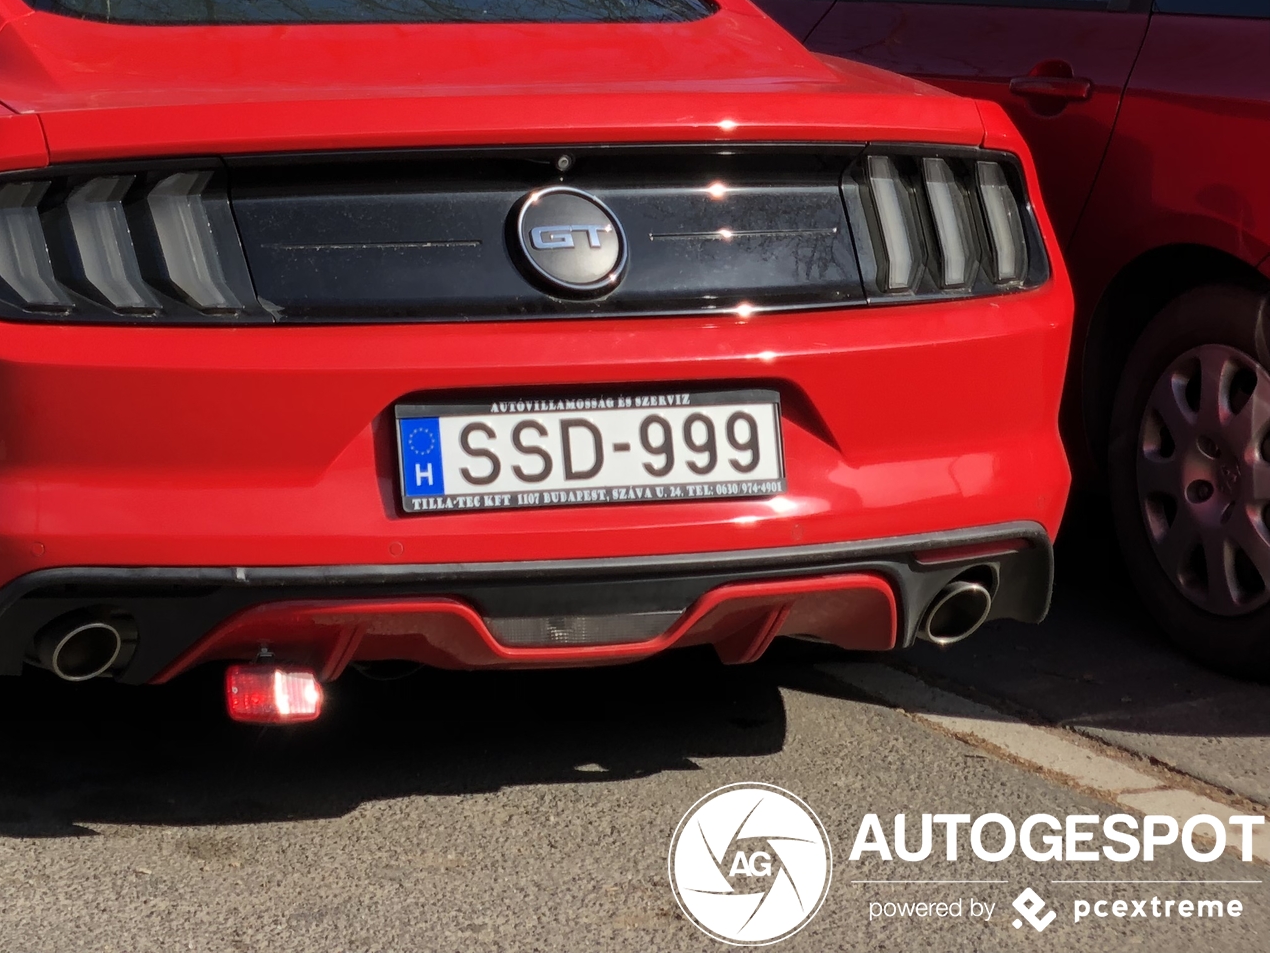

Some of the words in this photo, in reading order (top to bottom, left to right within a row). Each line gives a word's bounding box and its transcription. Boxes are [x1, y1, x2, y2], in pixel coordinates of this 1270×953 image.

[530, 224, 612, 250] GT
[490, 395, 614, 413] AUTÓVILLAMOSSÁG
[617, 393, 632, 407] ÉS
[635, 393, 690, 407] SZERVIZ
[460, 410, 760, 485] SSD-999
[415, 463, 433, 486] H
[484, 494, 511, 507] KFT
[518, 492, 539, 505] 1107
[543, 489, 610, 504] BUDAPEST,
[612, 486, 652, 501] SZÁVA
[656, 486, 667, 498] U.
[670, 486, 684, 497] 24.
[686, 485, 714, 497] TEL:
